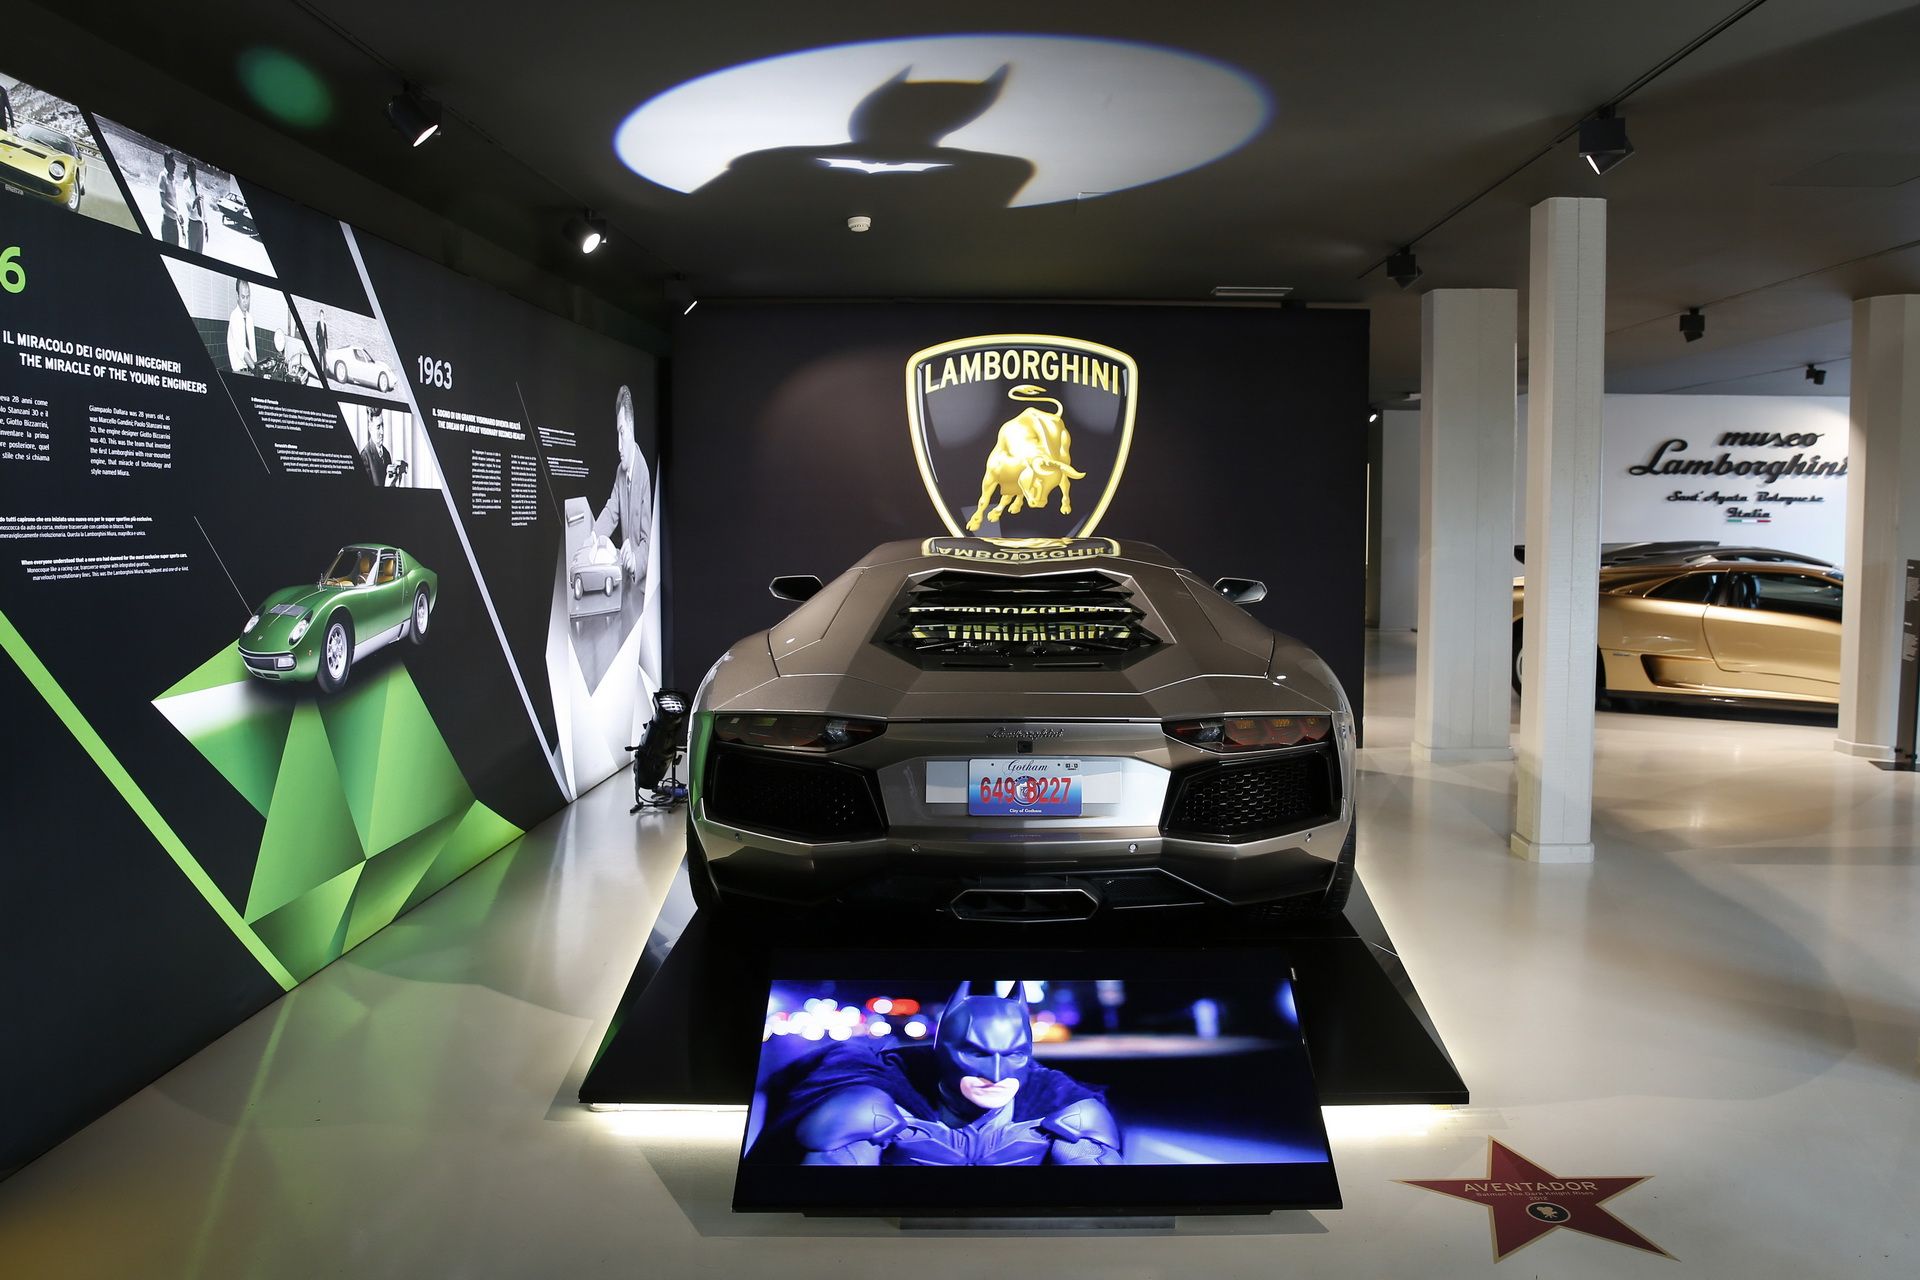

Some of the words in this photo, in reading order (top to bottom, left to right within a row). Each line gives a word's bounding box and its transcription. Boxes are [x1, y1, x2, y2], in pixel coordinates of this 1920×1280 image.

[3, 330, 14, 344] IL
[17, 332, 74, 354] MIRACOLO
[76, 344, 92, 358] DEI
[95, 347, 133, 365] GIOVANI
[136, 355, 181, 374] INGEGNERI
[19, 352, 42, 368] THE
[45, 356, 91, 376] MIRACLE
[93, 365, 106, 378] OF
[108, 367, 127, 381] THE
[129, 371, 160, 386] YOUNG
[162, 376, 207, 394] ENGINEERS
[418, 355, 452, 390] 1963
[925, 350, 1120, 394] LAMBORGHINI
[1719, 432, 1825, 448] museo
[1629, 438, 1848, 484] Lamborghini
[1726, 507, 1771, 518] Italia
[1008, 760, 1048, 772] Gotham
[981, 777, 1015, 804] 649
[1027, 777, 1072, 804] 8227
[1464, 1181, 1598, 1192] AVENTADOR
